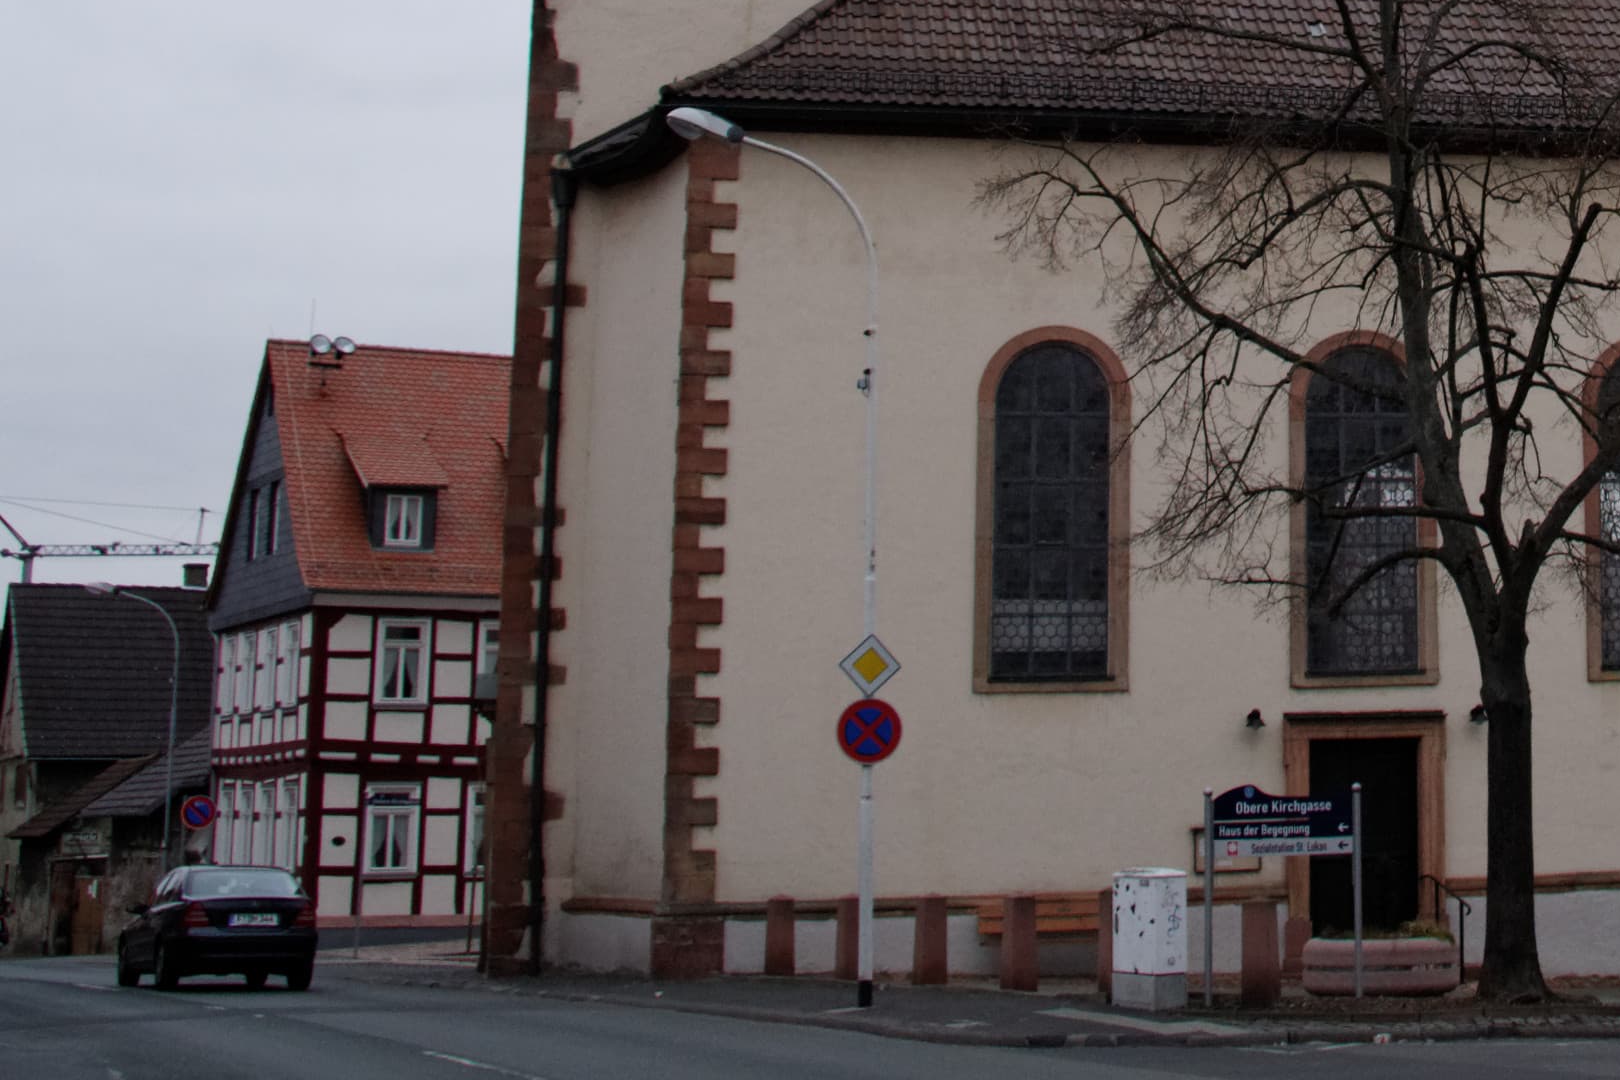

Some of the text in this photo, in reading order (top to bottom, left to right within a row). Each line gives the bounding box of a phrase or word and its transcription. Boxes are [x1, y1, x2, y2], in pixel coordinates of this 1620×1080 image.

[1235, 800, 1332, 814] Obere Kirchgasse
[1218, 824, 1311, 838] Haus der Begegnung
[1251, 842, 1295, 855] Sozialstation
[1306, 841, 1328, 852] Lukas
